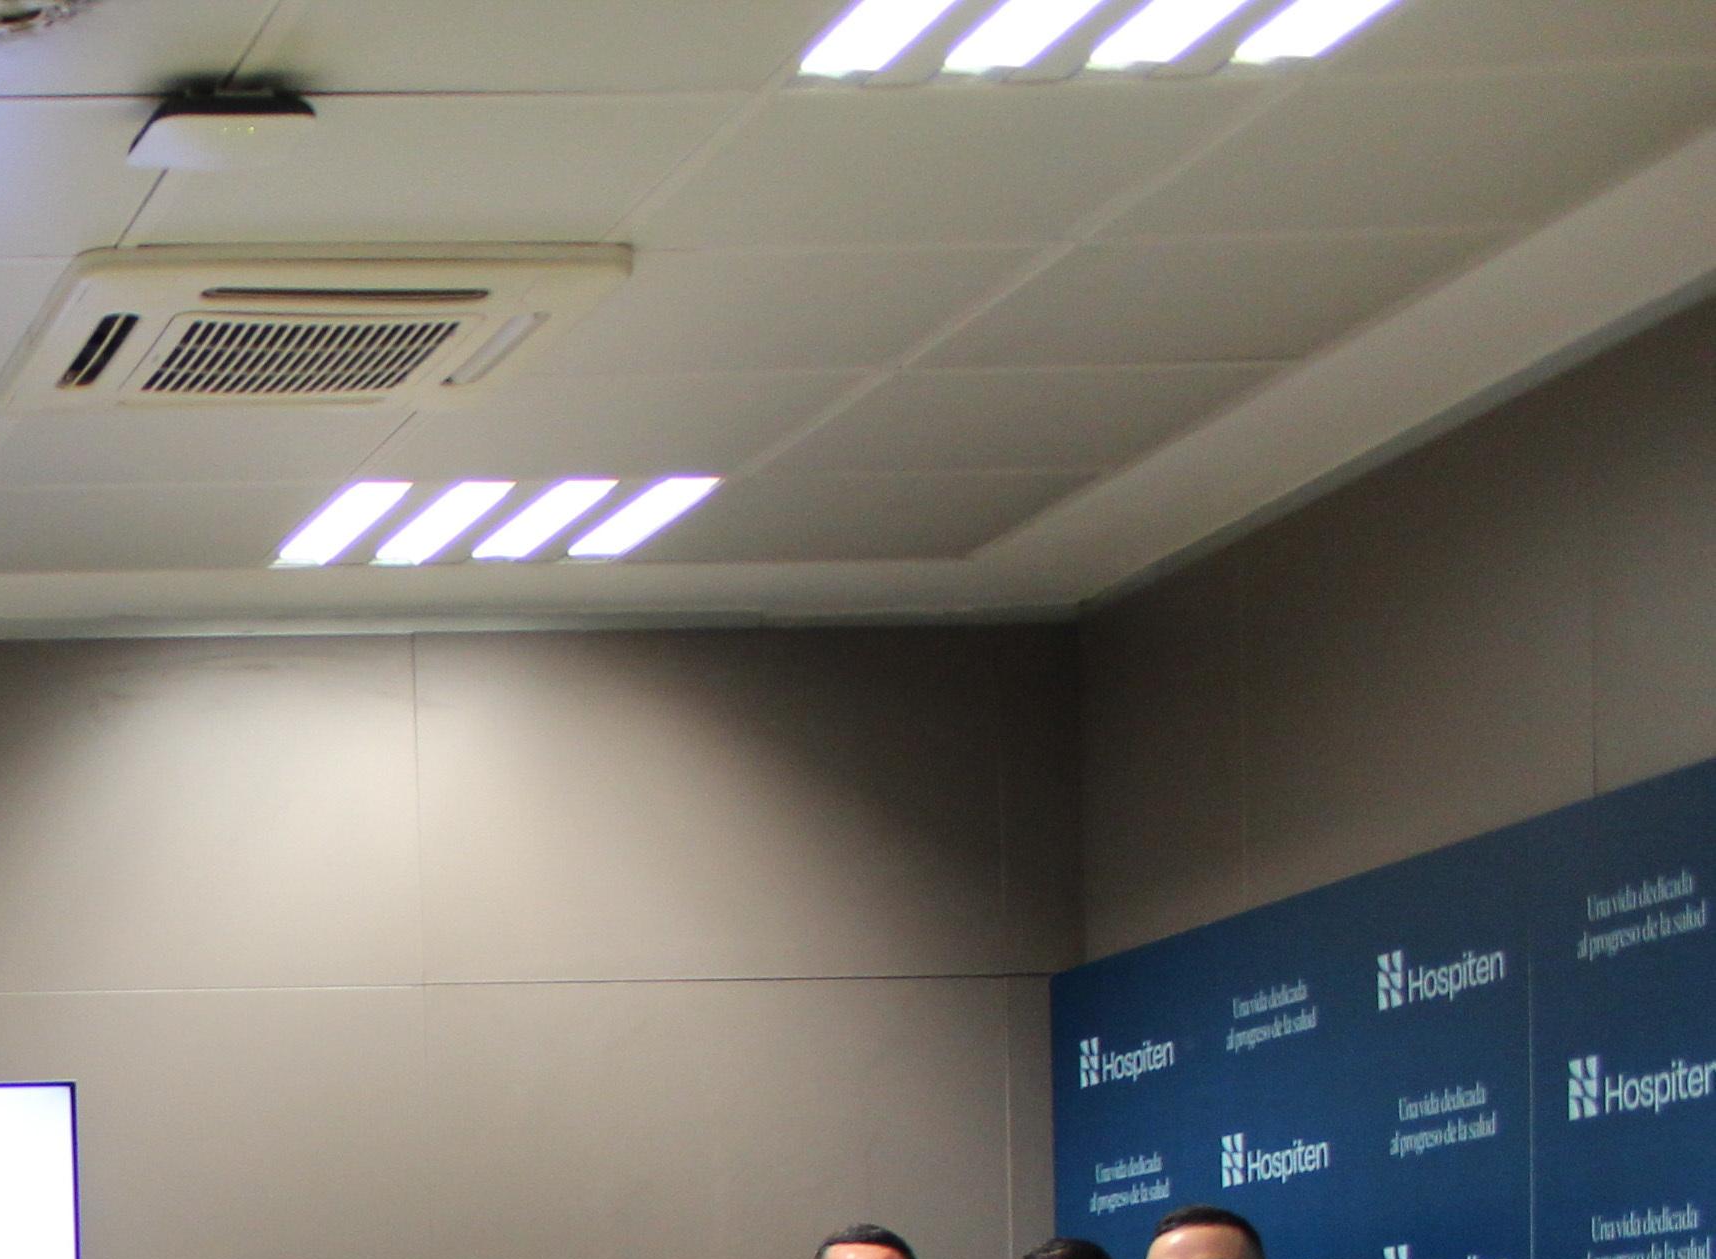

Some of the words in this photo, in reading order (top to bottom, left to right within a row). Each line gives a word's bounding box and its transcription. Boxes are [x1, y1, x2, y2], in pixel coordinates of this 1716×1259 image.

[1408, 951, 1506, 1001] Hospiten
[1102, 1039, 1175, 1081] Hospiten
[1247, 1138, 1329, 1182] Hospiten
[1591, 1215, 1615, 1243] Una
[1616, 1210, 1642, 1239] vida
[1642, 1203, 1698, 1236] dedicada
